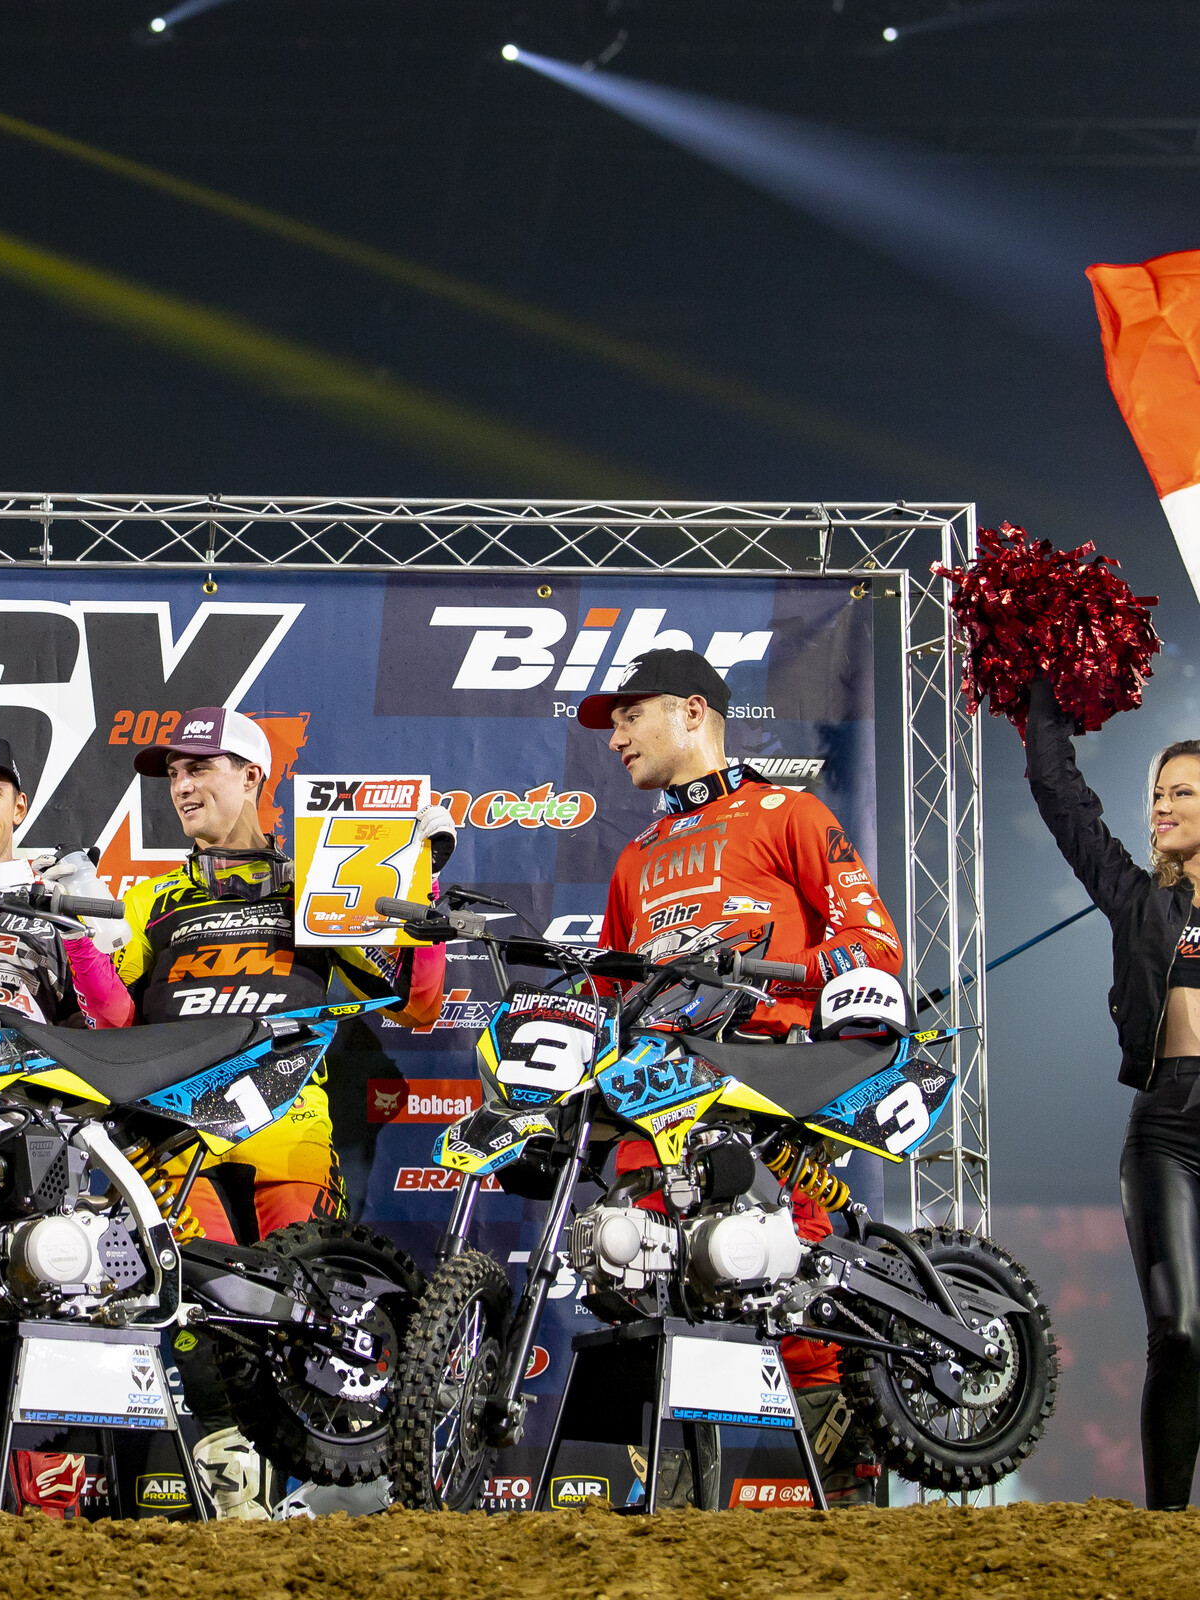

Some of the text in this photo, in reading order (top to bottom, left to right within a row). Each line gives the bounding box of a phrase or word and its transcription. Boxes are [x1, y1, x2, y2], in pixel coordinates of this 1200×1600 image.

[429, 605, 774, 692] Bihr
[726, 702, 776, 720] ssion
[108, 710, 185, 745] 202
[724, 757, 827, 779] NSWER
[306, 780, 416, 812] SX TOUR
[490, 797, 581, 821] verte
[303, 816, 419, 938] 3
[639, 838, 729, 896] KENNY
[648, 902, 702, 934] Bihr
[168, 941, 296, 984] KTM
[172, 986, 288, 1017] Bihr
[508, 993, 608, 1028] SUPERCROSS
[826, 986, 899, 1013] Bihr
[495, 1020, 597, 1092] 3
[224, 1074, 274, 1135] 1
[407, 1094, 473, 1115] Bobcat
[875, 1081, 932, 1155] 3
[650, 1102, 698, 1135] SUPERCROSS
[489, 1148, 517, 1170] 2021
[24, 1410, 166, 1428] YCF-RIDING.COM
[126, 1405, 164, 1415] DAYTONA
[673, 1408, 793, 1427] YCF-RIDING.COM
[760, 1405, 792, 1415] DAYTONA
[142, 1492, 187, 1501] PROTEK
[143, 1479, 187, 1493] AIR
[558, 1481, 602, 1495] AIR
[558, 1495, 590, 1503] PROT
